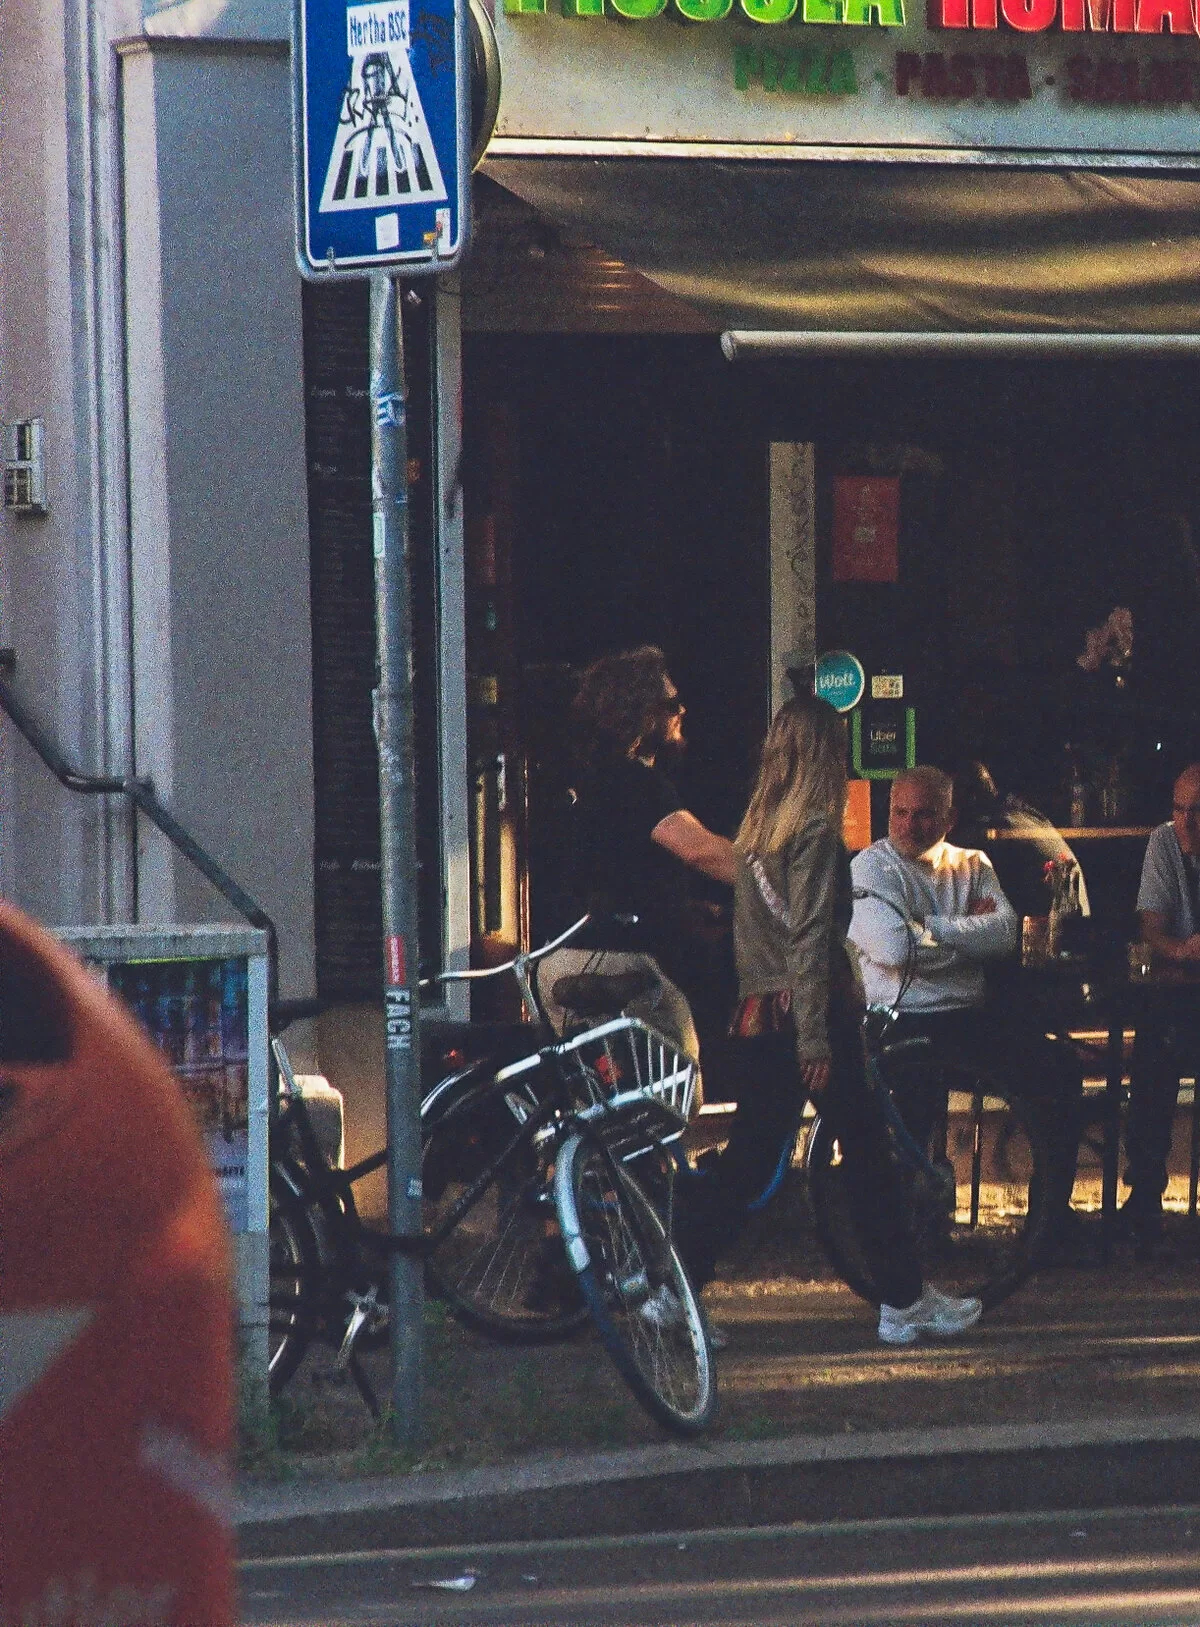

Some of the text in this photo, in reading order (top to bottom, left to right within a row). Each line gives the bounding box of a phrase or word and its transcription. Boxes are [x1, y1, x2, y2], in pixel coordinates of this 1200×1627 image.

[388, 9, 407, 42] BSC
[734, 46, 858, 95] PIZZA
[895, 50, 1033, 100] PASTA
[870, 729, 896, 742] Uber
